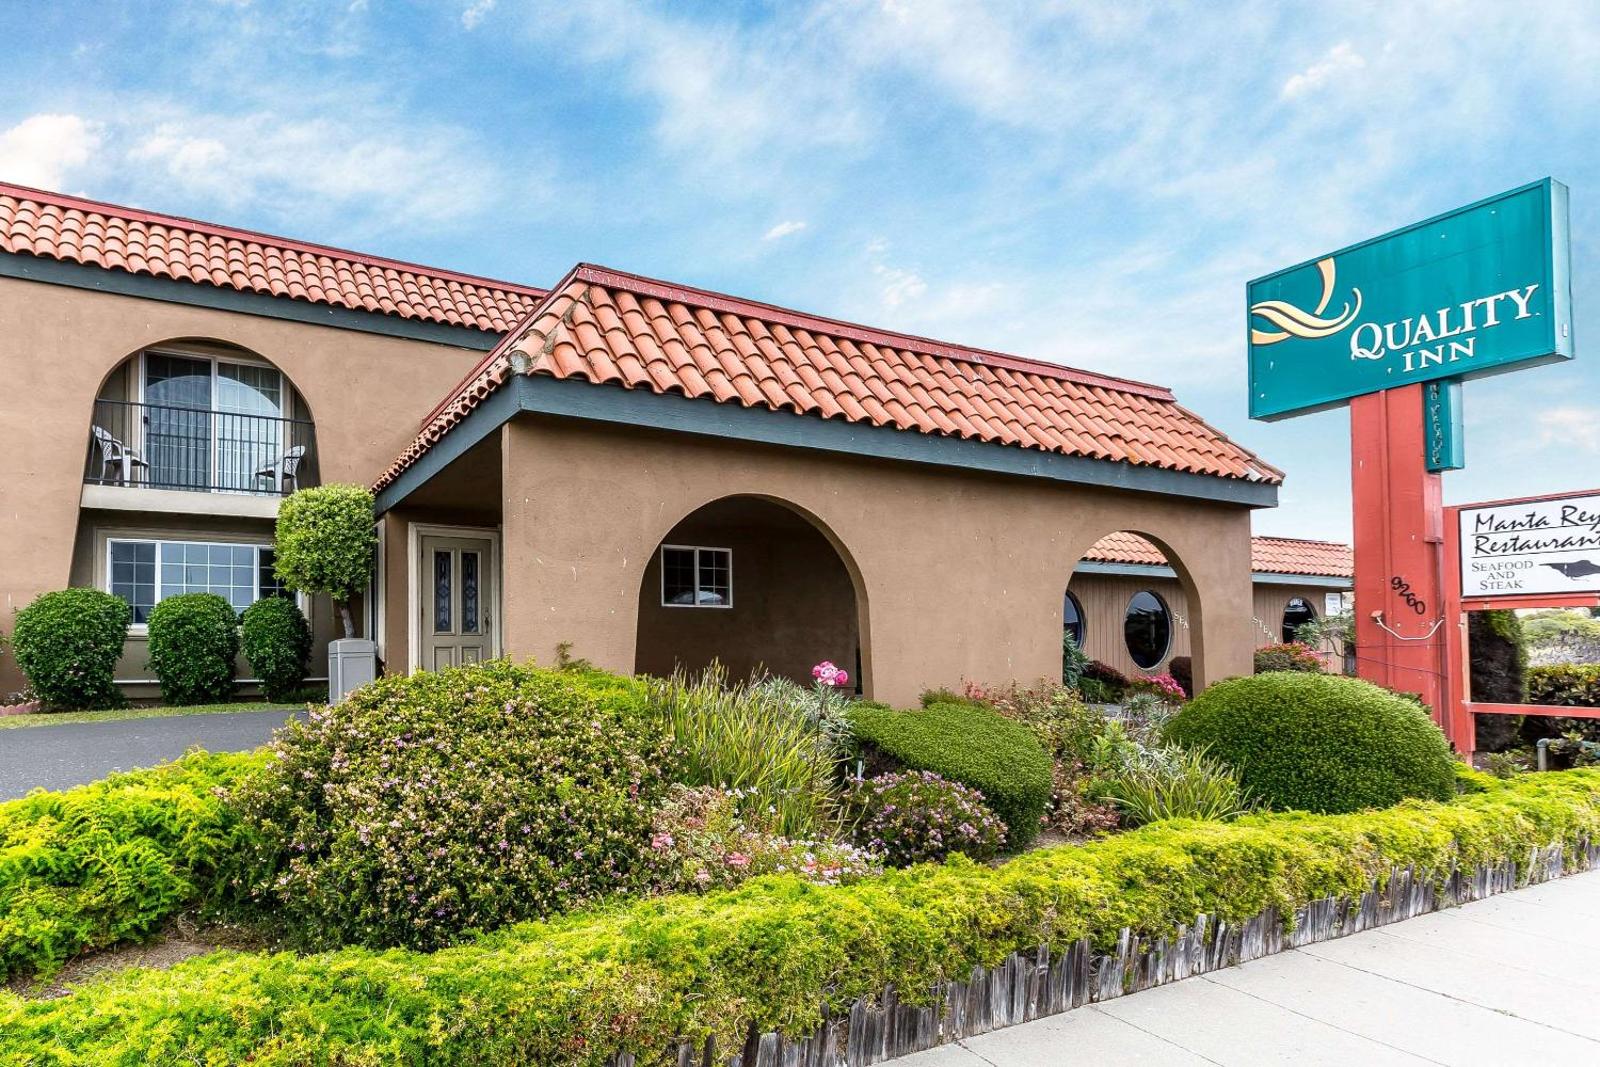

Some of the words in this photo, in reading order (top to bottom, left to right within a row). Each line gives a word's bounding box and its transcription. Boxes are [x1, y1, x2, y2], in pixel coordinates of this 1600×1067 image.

[1350, 284, 1539, 360] QUALITY
[1403, 337, 1476, 373] INN
[1474, 512, 1550, 532] Manta
[1471, 560, 1534, 572] SEAFOOD
[1487, 571, 1515, 580] AND
[1480, 579, 1523, 590] STEAK
[1391, 576, 1426, 615] 9260
